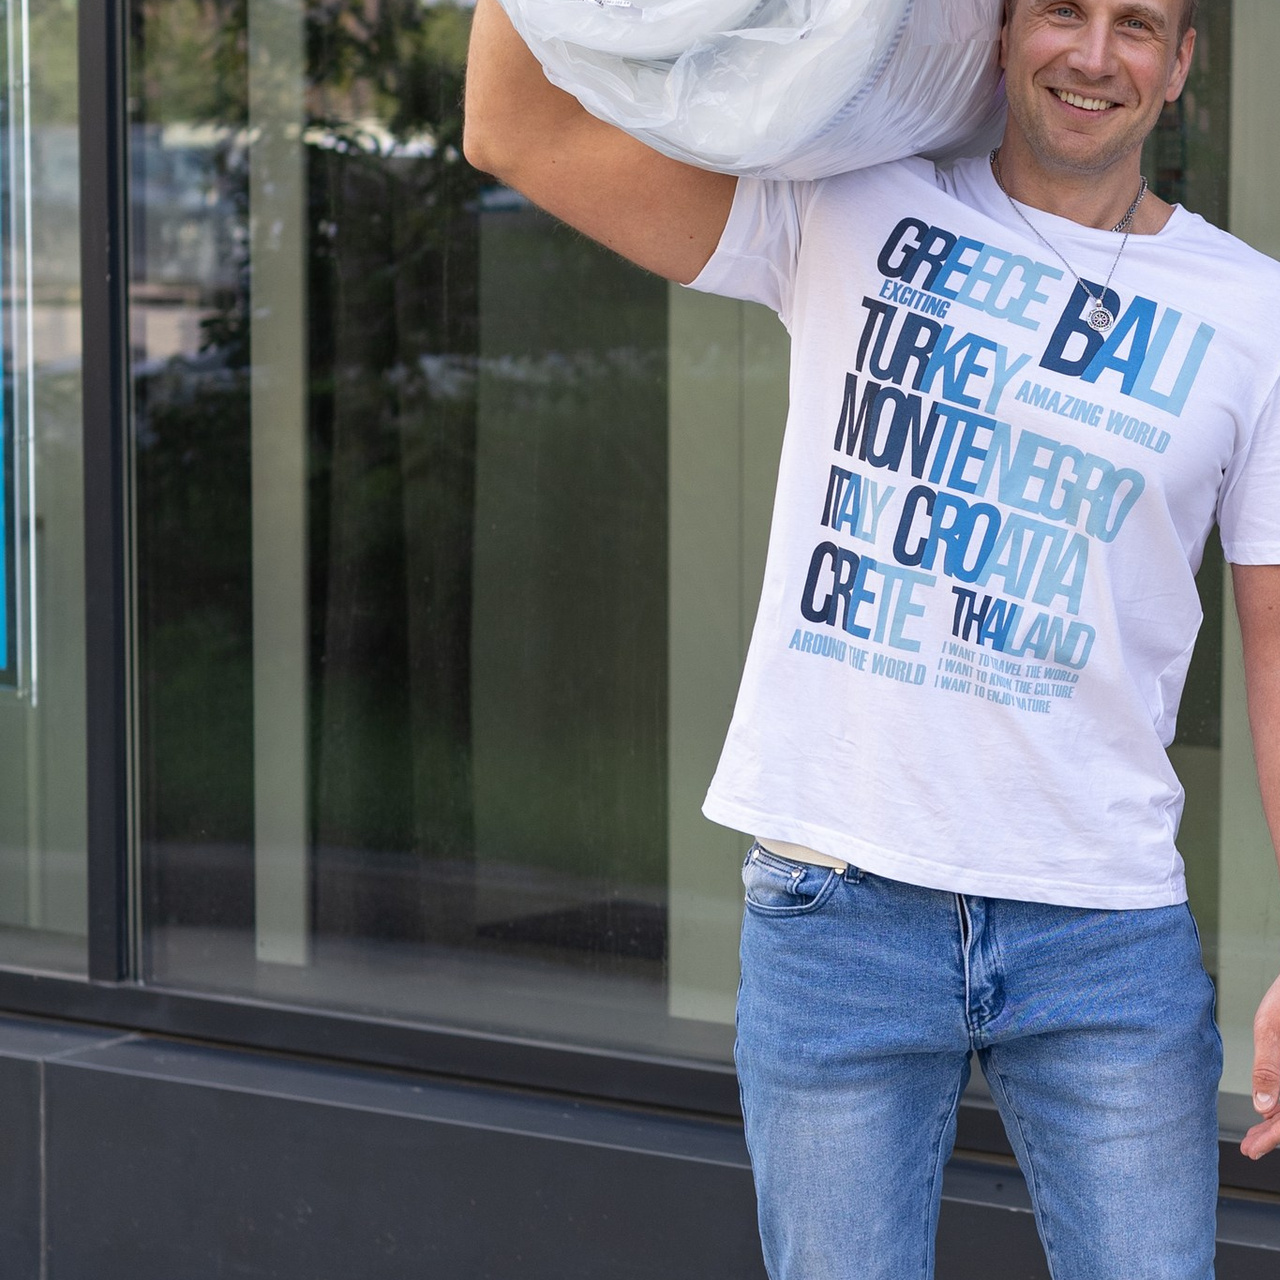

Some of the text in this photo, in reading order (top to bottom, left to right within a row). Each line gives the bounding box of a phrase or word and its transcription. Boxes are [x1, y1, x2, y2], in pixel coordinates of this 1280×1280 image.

[877, 217, 1216, 417] GREECE BALI
[879, 279, 952, 319] EXCITING
[857, 296, 1032, 415] TURKEY
[1015, 380, 1171, 454] AMAZING WORLD
[834, 372, 1146, 543] MONTENEGRO
[821, 464, 1090, 616] ITALY CROATIA
[800, 541, 1096, 670] CRETE THAILAND
[789, 629, 927, 685] AROUND THE WORLD
[934, 675, 940, 688] I
[941, 675, 972, 694] WANT
[974, 685, 985, 698] TO
[937, 658, 943, 670] I
[945, 659, 973, 678] WANT
[976, 669, 987, 683] TO
[1015, 680, 1033, 695] THE
[1034, 682, 1075, 699] CULTURE
[941, 641, 948, 654] I
[948, 642, 976, 663] WANT
[979, 652, 990, 667] TO
[1025, 664, 1043, 679] THE
[1044, 667, 1079, 684] WORLD
